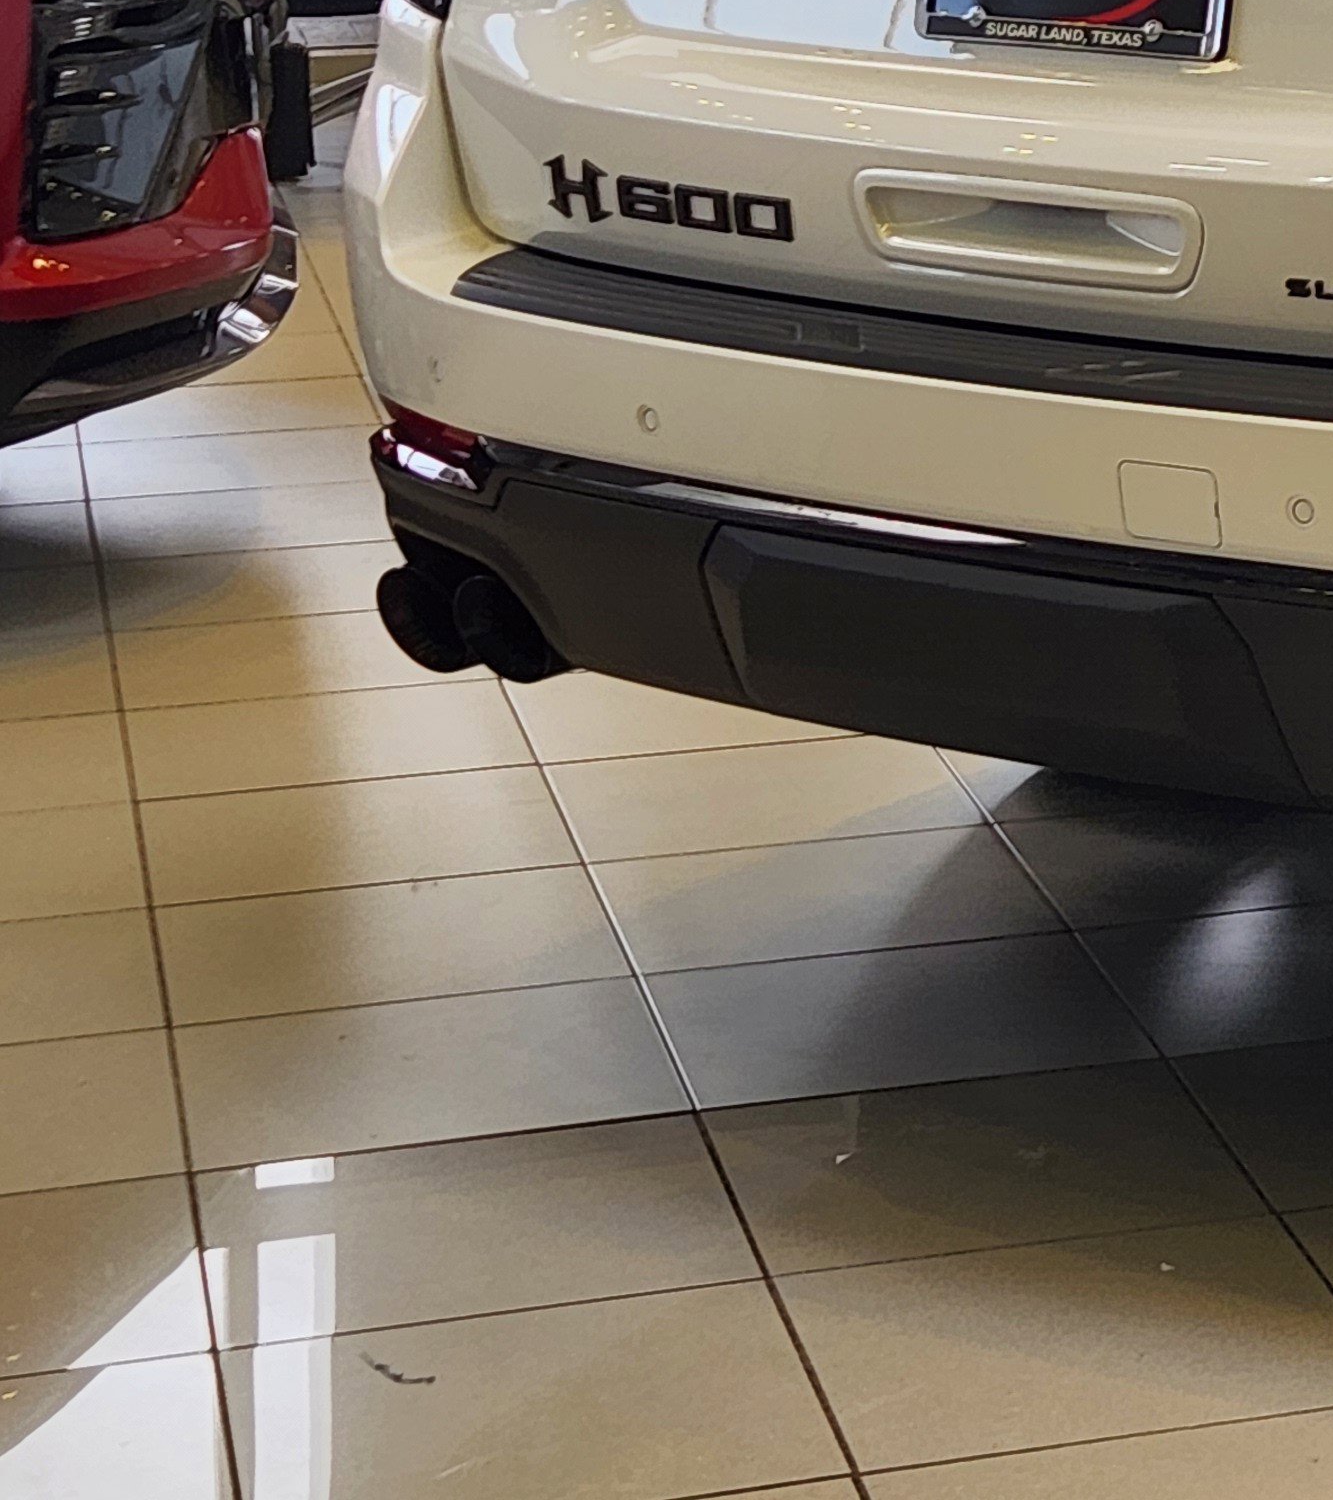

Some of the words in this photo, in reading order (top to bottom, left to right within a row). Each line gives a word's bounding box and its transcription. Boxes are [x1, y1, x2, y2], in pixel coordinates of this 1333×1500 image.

[985, 21, 1038, 39] SUGAR
[1040, 25, 1087, 45] LAND,
[1090, 30, 1143, 47] TEXAS
[543, 154, 795, 243] H600
